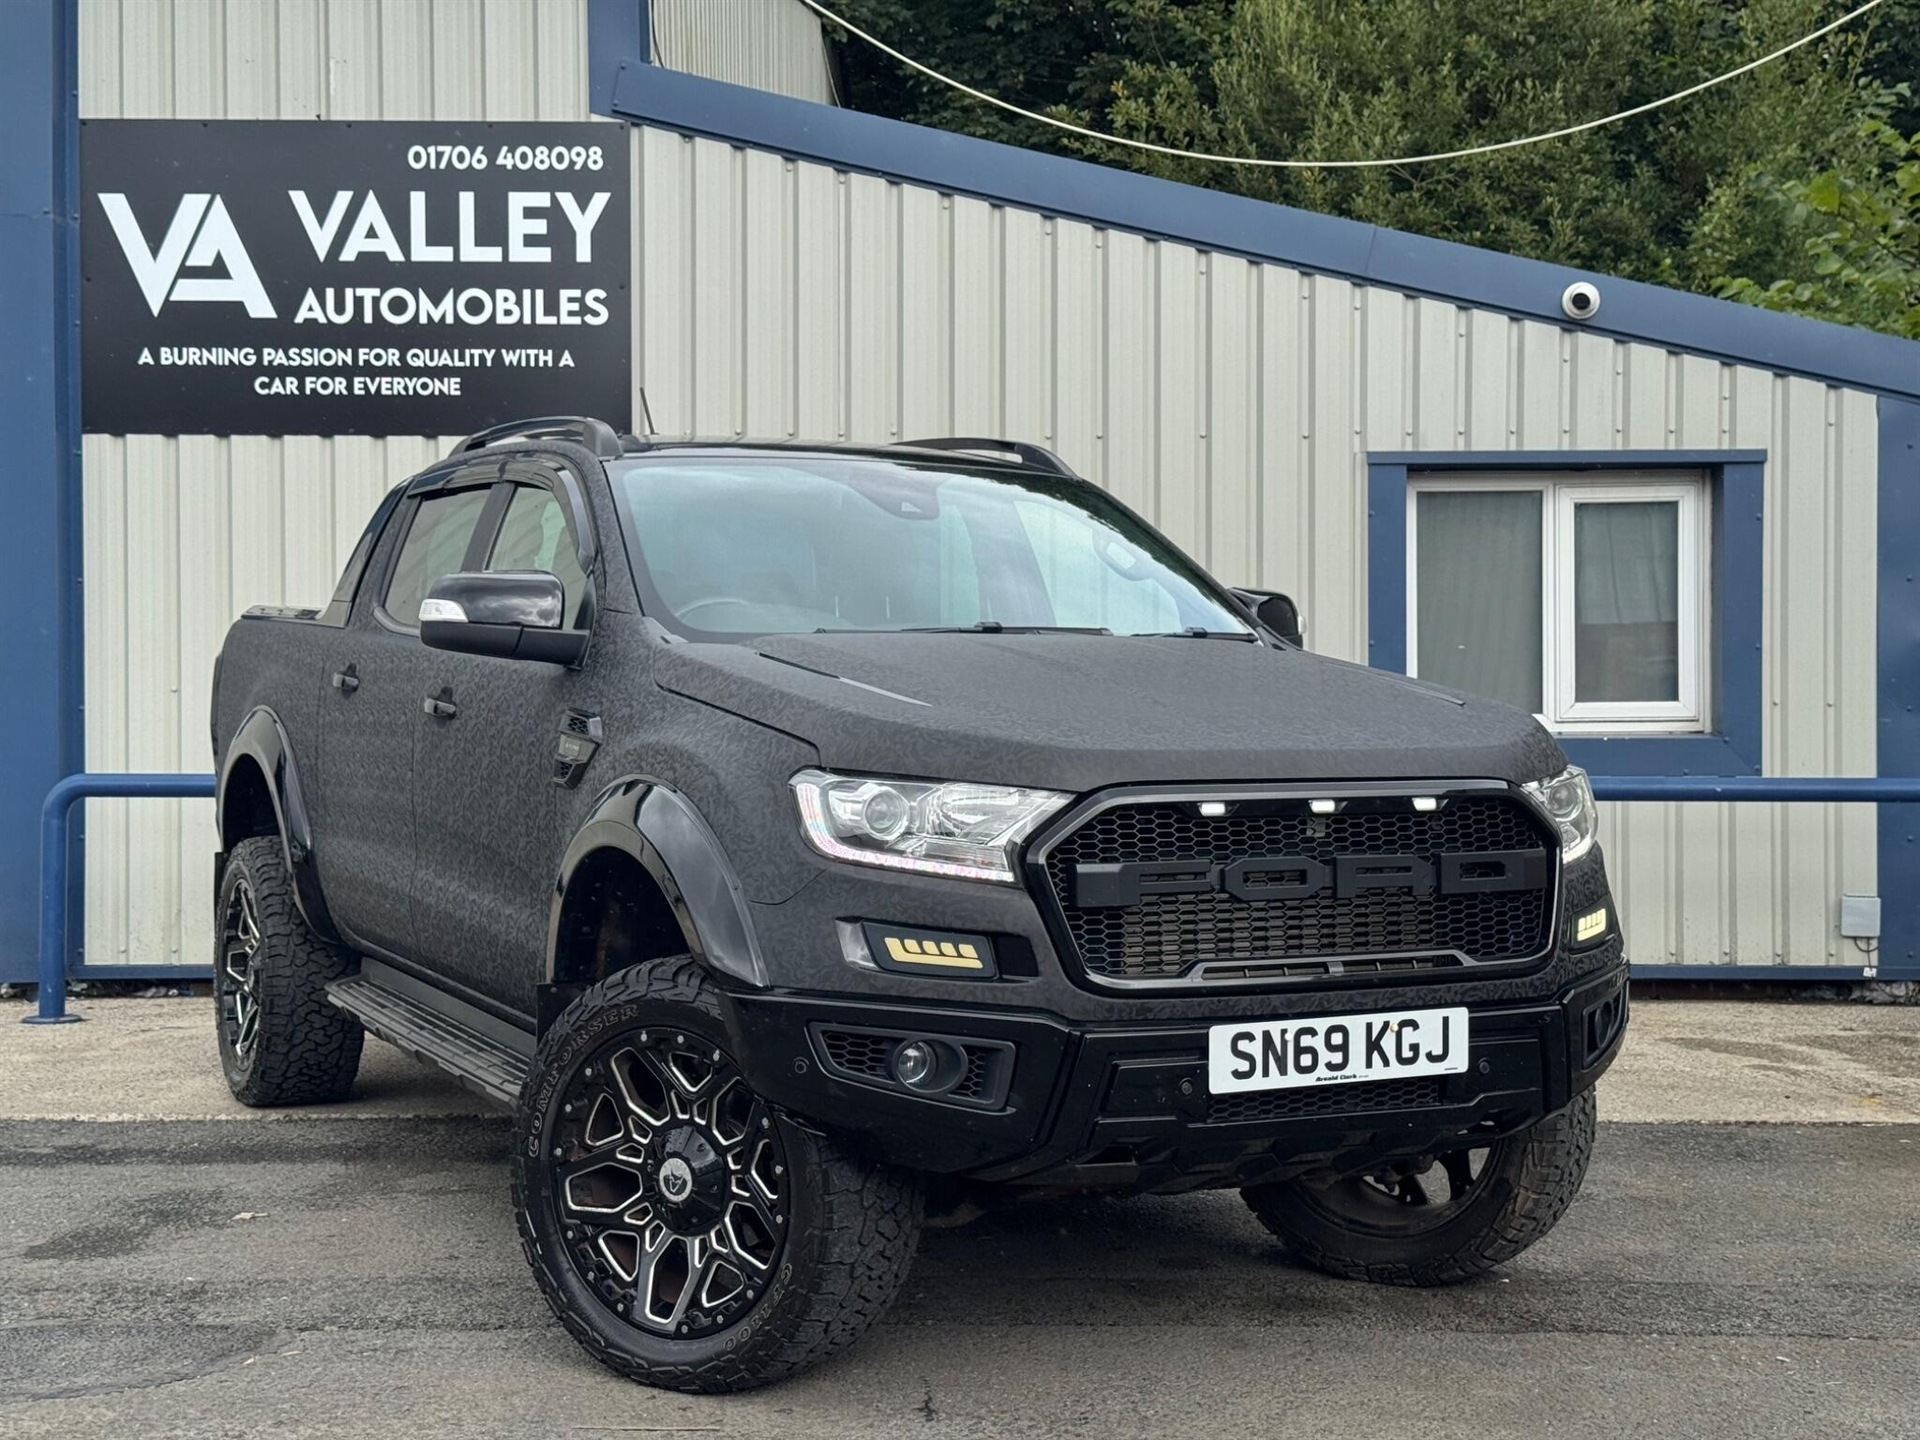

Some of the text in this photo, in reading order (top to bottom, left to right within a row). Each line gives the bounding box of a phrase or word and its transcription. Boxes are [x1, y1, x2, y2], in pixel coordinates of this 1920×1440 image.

[407, 145, 604, 171] 01706 408098
[288, 189, 612, 263] VALLEY
[97, 192, 278, 319] VA
[294, 287, 609, 326] AUTOMOBILES
[137, 347, 575, 368] A BURNING PASSION FOR QUALITY WITH A
[253, 376, 462, 396] CAR FOR EVERYONE
[1075, 849, 1547, 907] FORD
[1229, 1015, 1451, 1081] SN69 KGJ
